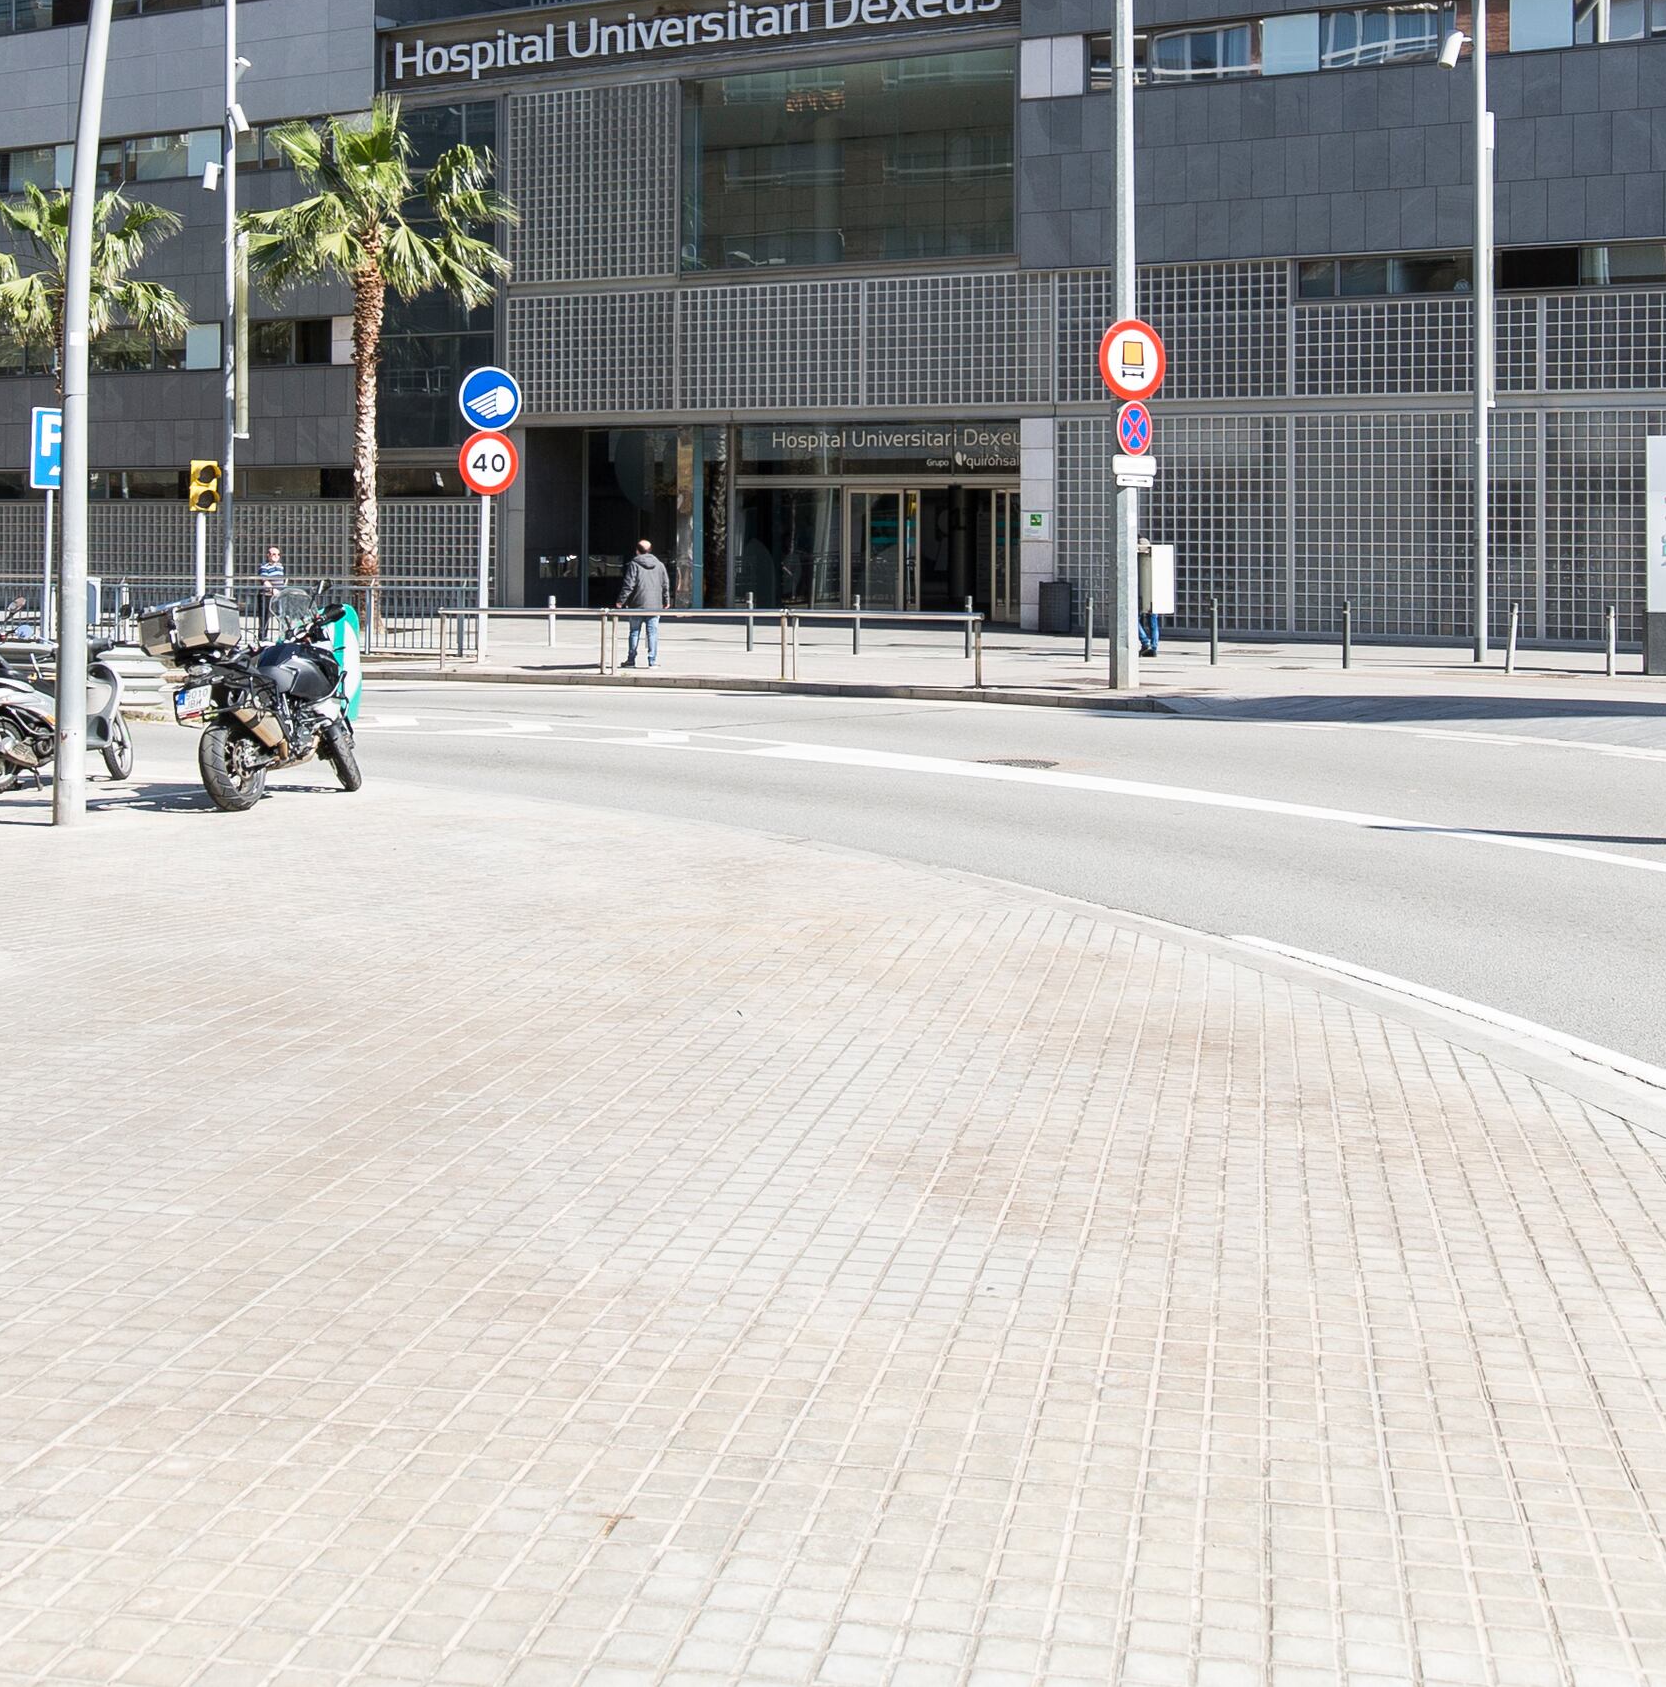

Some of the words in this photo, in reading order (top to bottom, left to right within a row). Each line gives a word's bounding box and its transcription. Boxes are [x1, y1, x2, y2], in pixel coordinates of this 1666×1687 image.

[394, 22, 555, 80] Hospital
[40, 414, 62, 457] P
[772, 431, 846, 452] Hospital
[852, 429, 957, 448] Universitari
[472, 453, 506, 473] 40
[926, 458, 950, 468] Grupo
